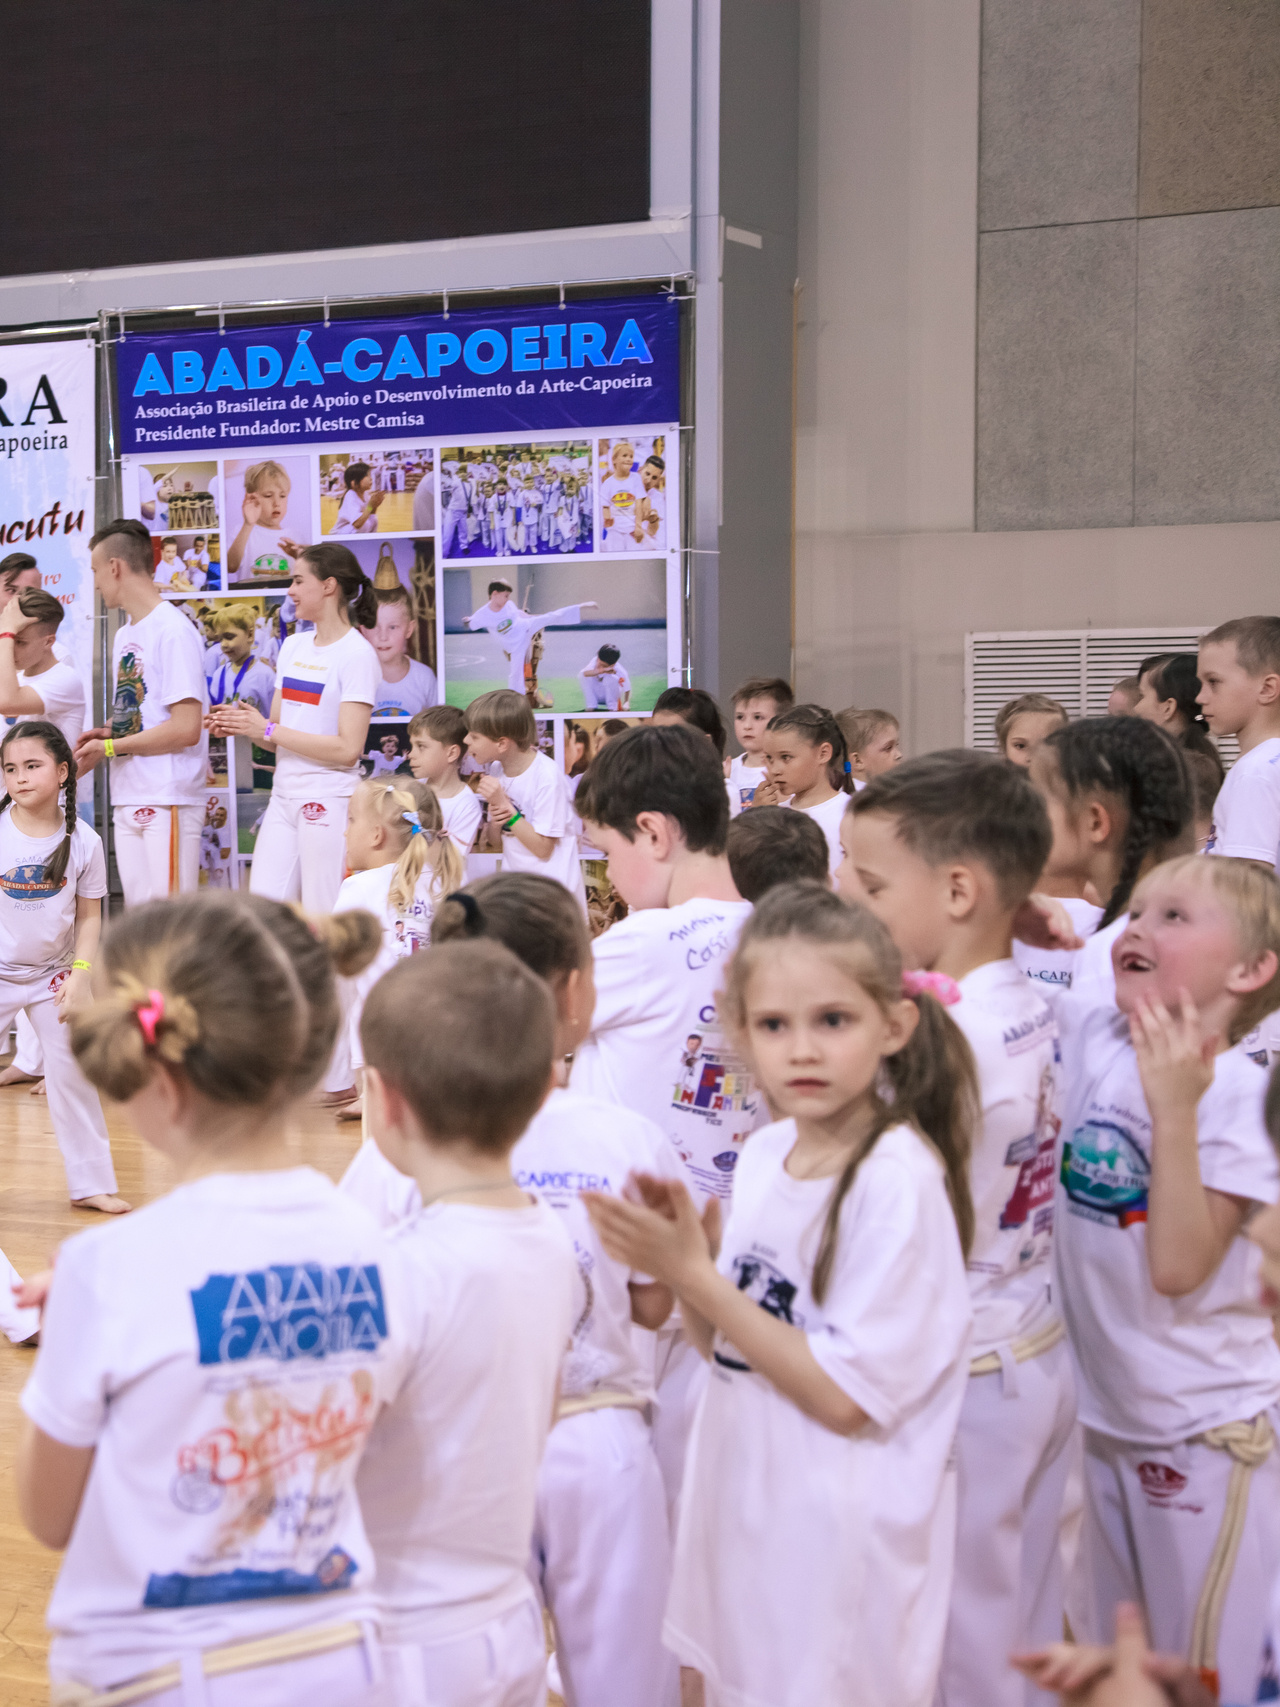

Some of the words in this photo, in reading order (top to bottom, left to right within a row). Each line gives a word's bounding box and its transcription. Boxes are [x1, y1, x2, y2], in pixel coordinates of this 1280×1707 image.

[132, 318, 654, 397] ABADÁ-CAPOEIRA
[134, 401, 213, 420] Associação
[216, 396, 287, 415] Brasileira
[290, 394, 309, 410] de
[312, 391, 359, 412] Apoio
[362, 393, 371, 405] e
[375, 384, 512, 404] Desenvolvimento
[515, 379, 535, 396] da
[539, 373, 653, 396] Arte-Capoeira
[135, 422, 216, 443] Presidente
[220, 418, 301, 438] Fundador:
[305, 414, 360, 433] Mestre
[364, 410, 425, 430] Camisa
